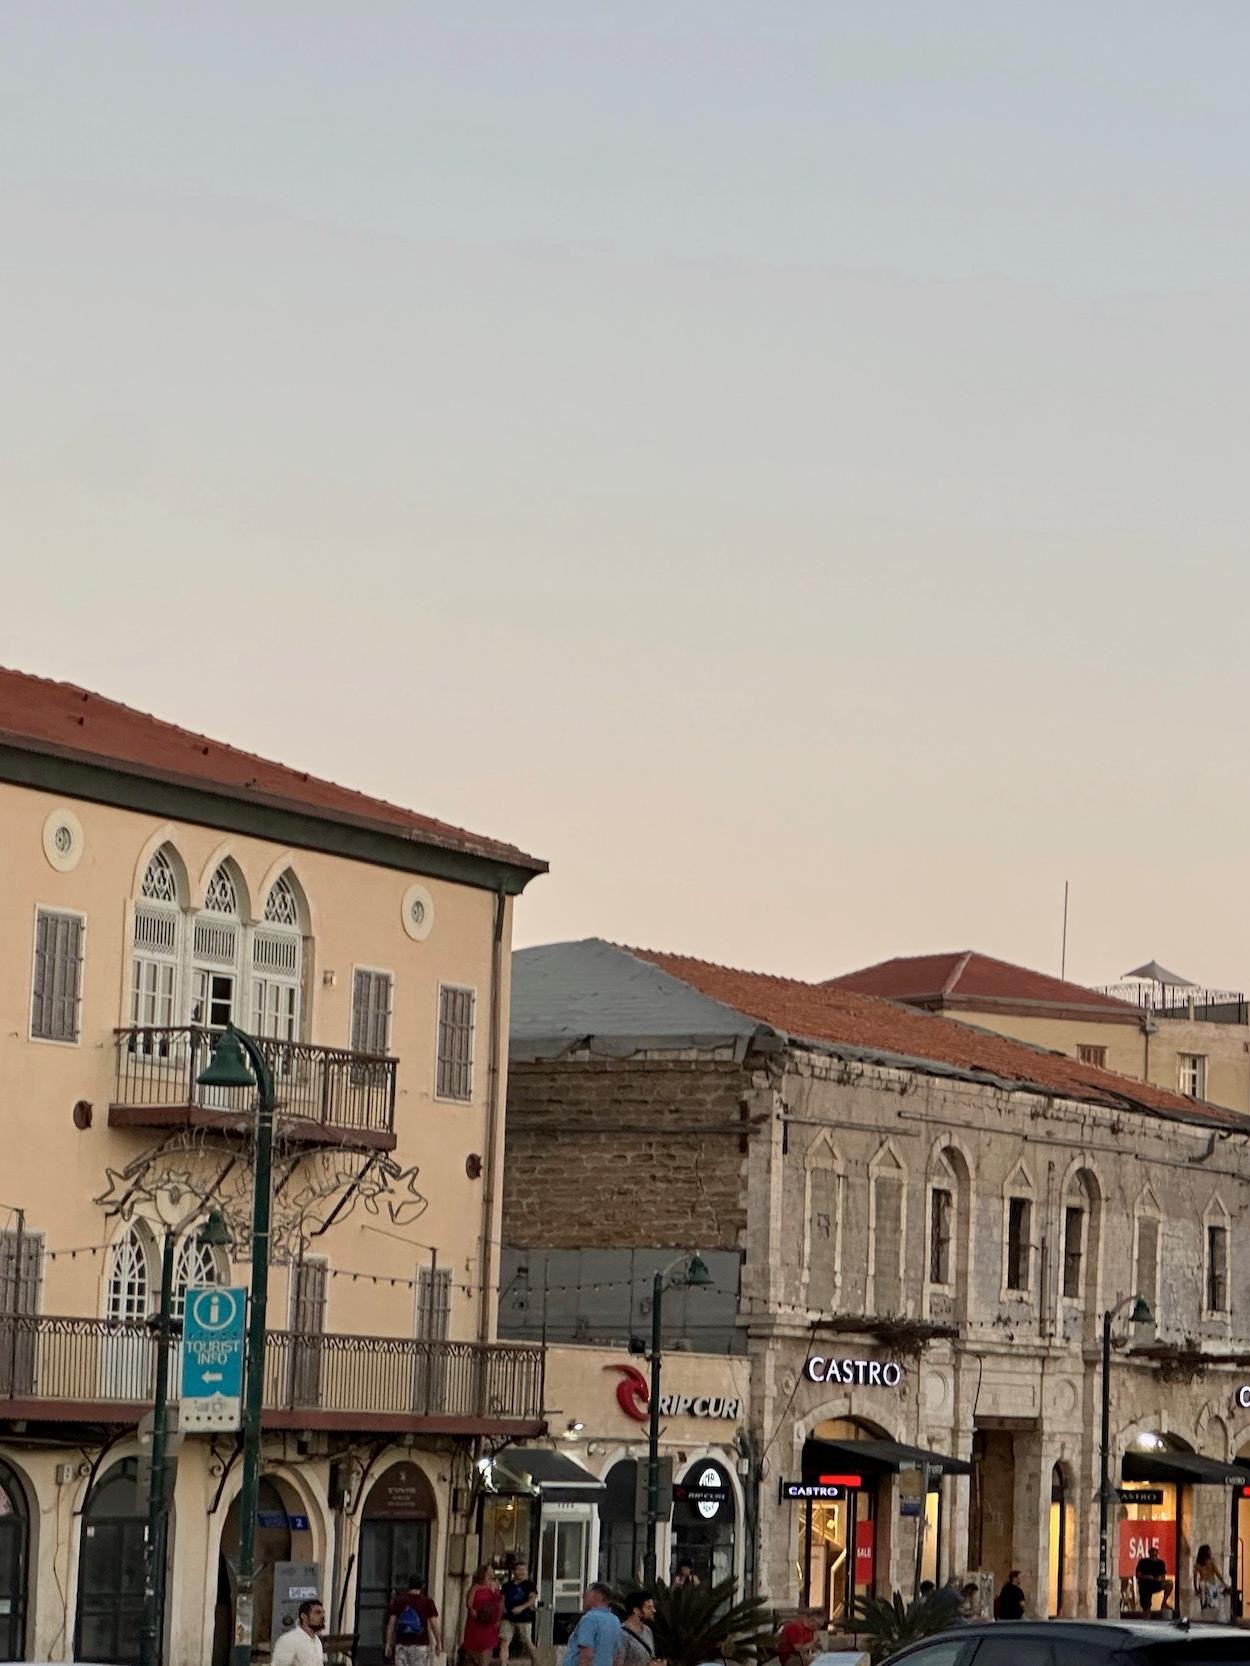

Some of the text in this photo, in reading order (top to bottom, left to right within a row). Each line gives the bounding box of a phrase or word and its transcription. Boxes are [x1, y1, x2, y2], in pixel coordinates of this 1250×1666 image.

[186, 1340, 241, 1354] TOURIST
[197, 1353, 228, 1366] INFO
[808, 1356, 901, 1387] CASTRO
[788, 1486, 839, 1497] CASTRO
[295, 1518, 303, 1528] 2
[857, 1547, 872, 1559] SALE
